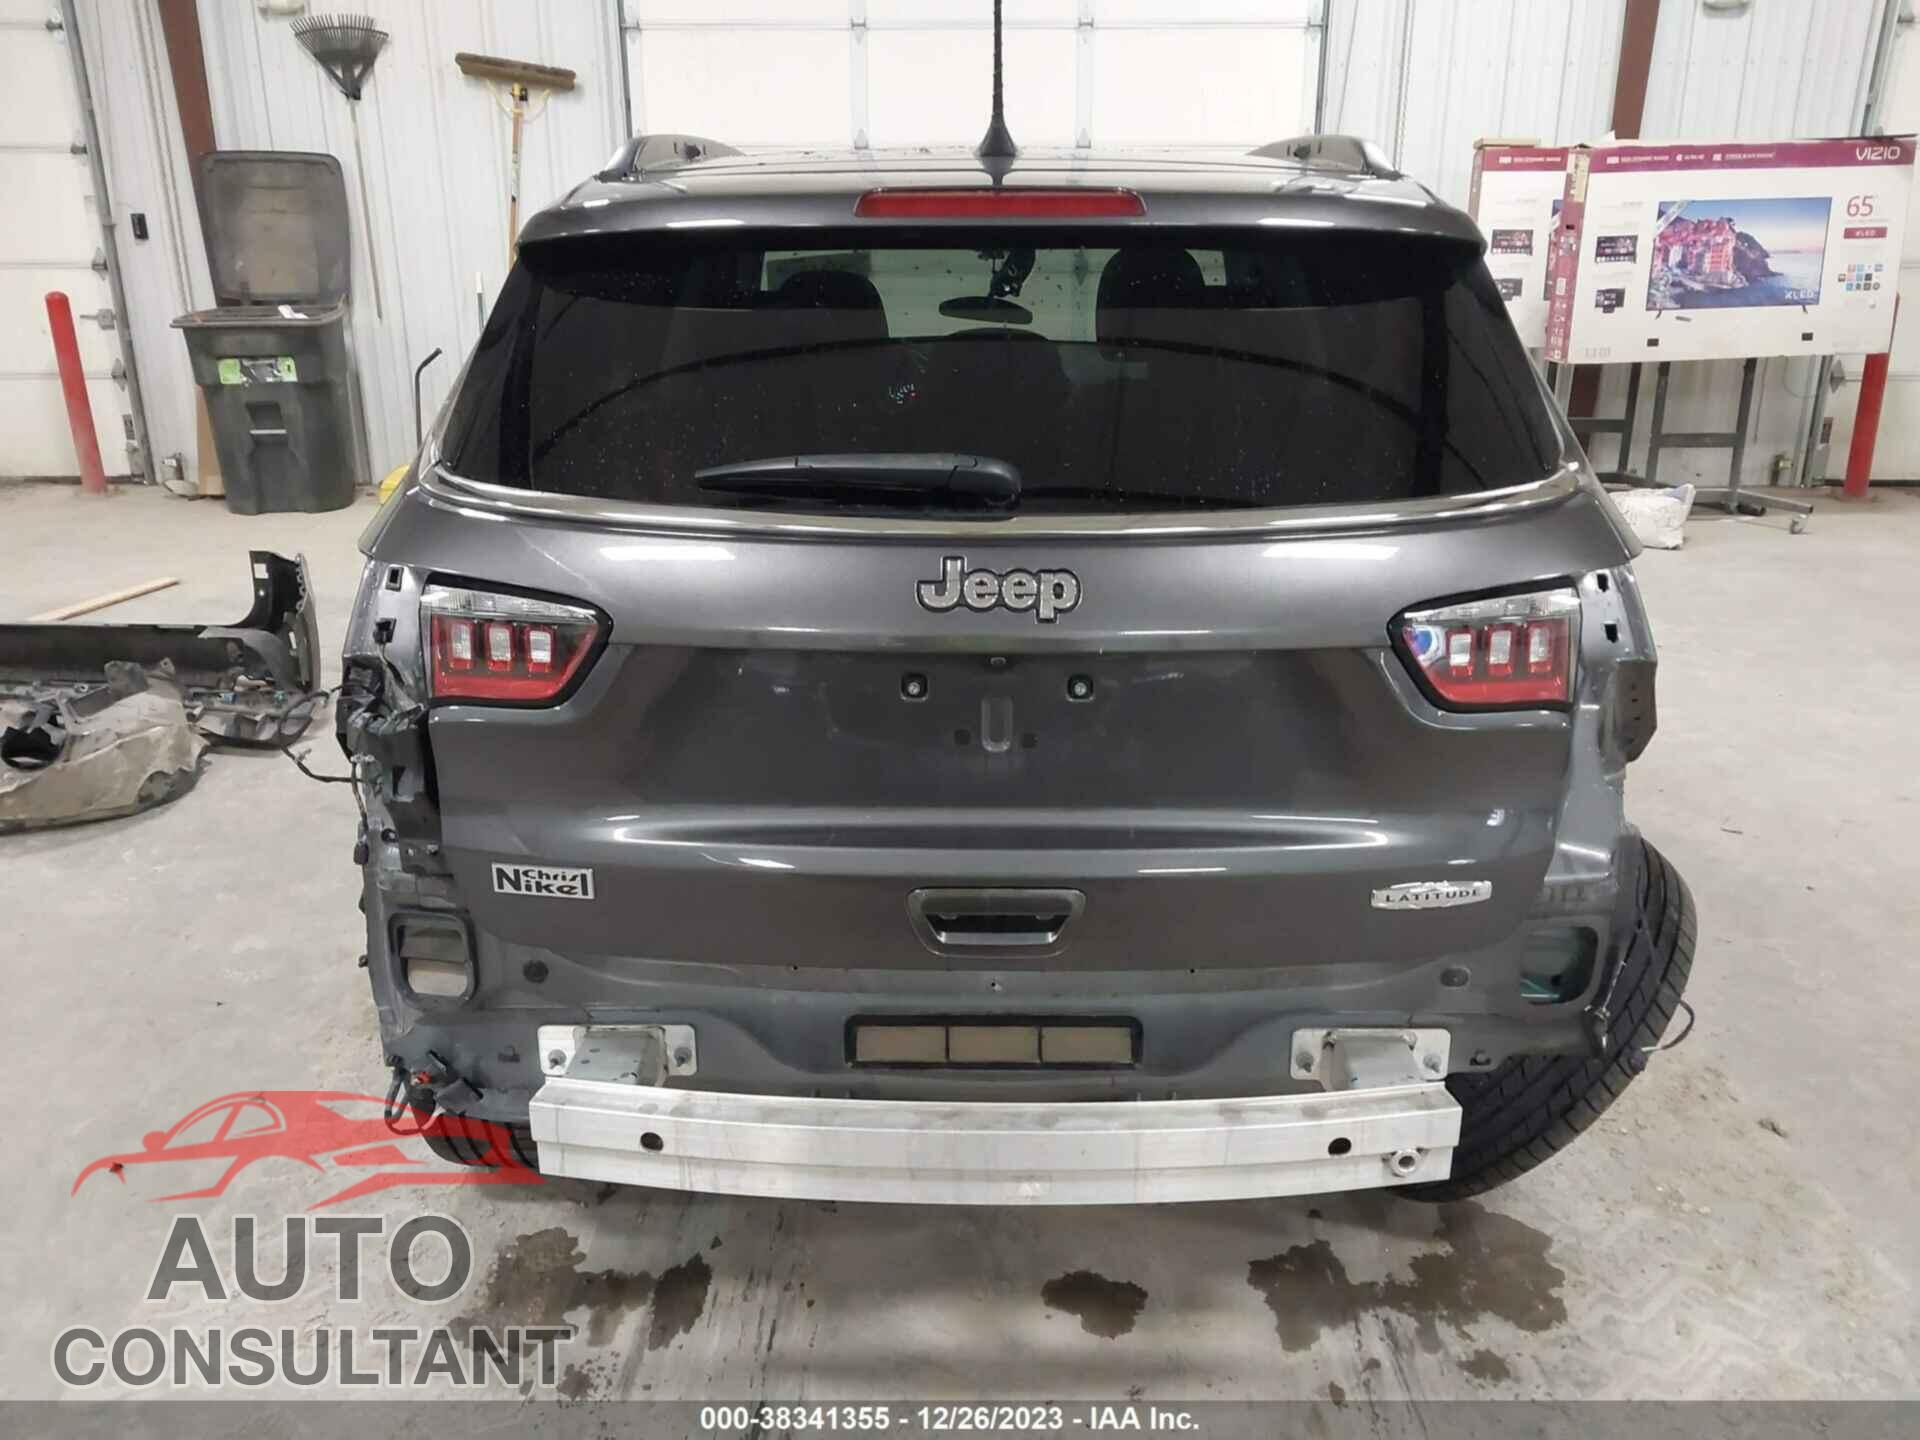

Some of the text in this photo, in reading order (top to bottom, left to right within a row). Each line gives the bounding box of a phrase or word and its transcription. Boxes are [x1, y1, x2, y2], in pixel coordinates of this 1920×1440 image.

[1856, 146, 1901, 161] VIZIO
[1846, 195, 1873, 218] 65
[918, 556, 1081, 622] Jeep
[521, 868, 579, 882] Chris
[1385, 889, 1480, 903] LATITUDE
